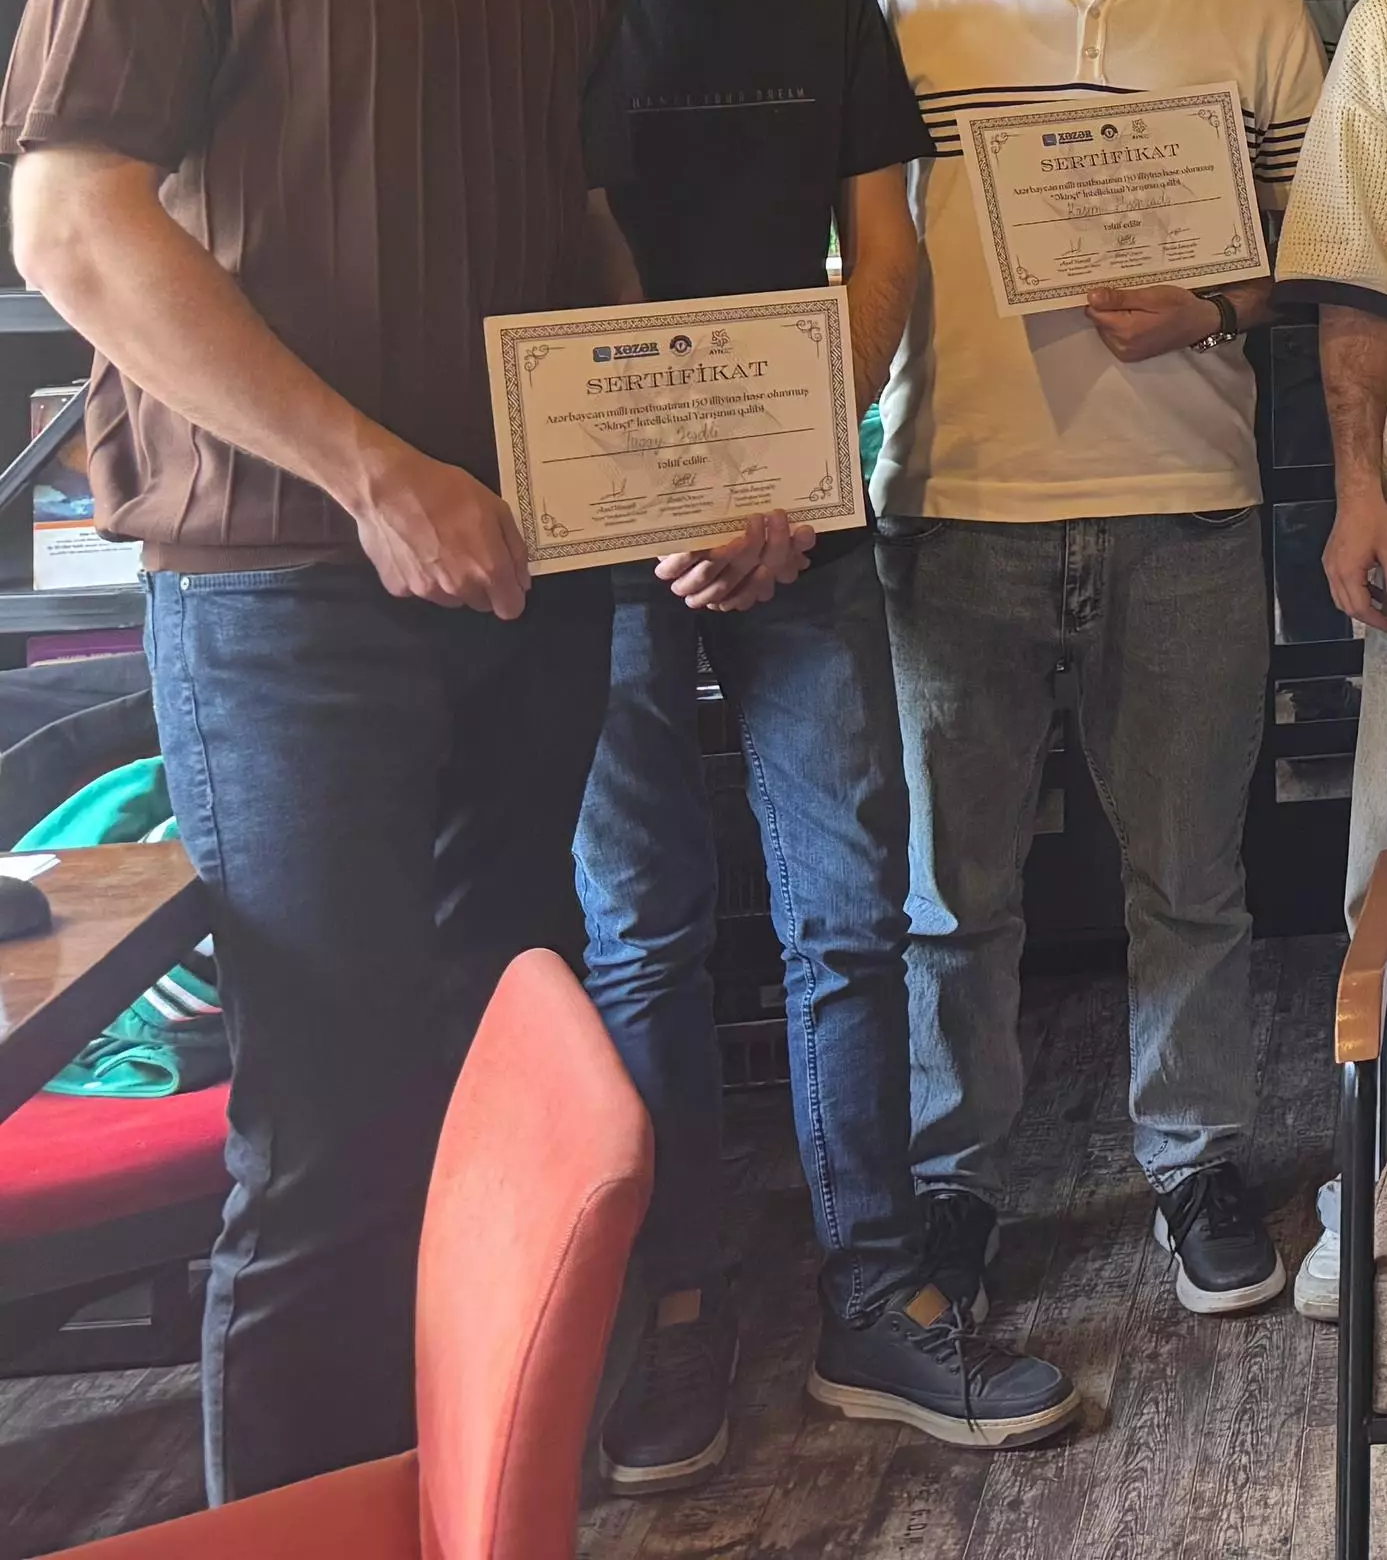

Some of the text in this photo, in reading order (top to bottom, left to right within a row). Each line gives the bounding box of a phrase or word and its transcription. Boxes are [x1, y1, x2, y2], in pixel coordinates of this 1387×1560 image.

[1039, 143, 1181, 174] SERTİFİKAT
[584, 359, 770, 395] SERTİFİKAT
[544, 408, 605, 425] Azərbaycan
[691, 397, 708, 407] 150
